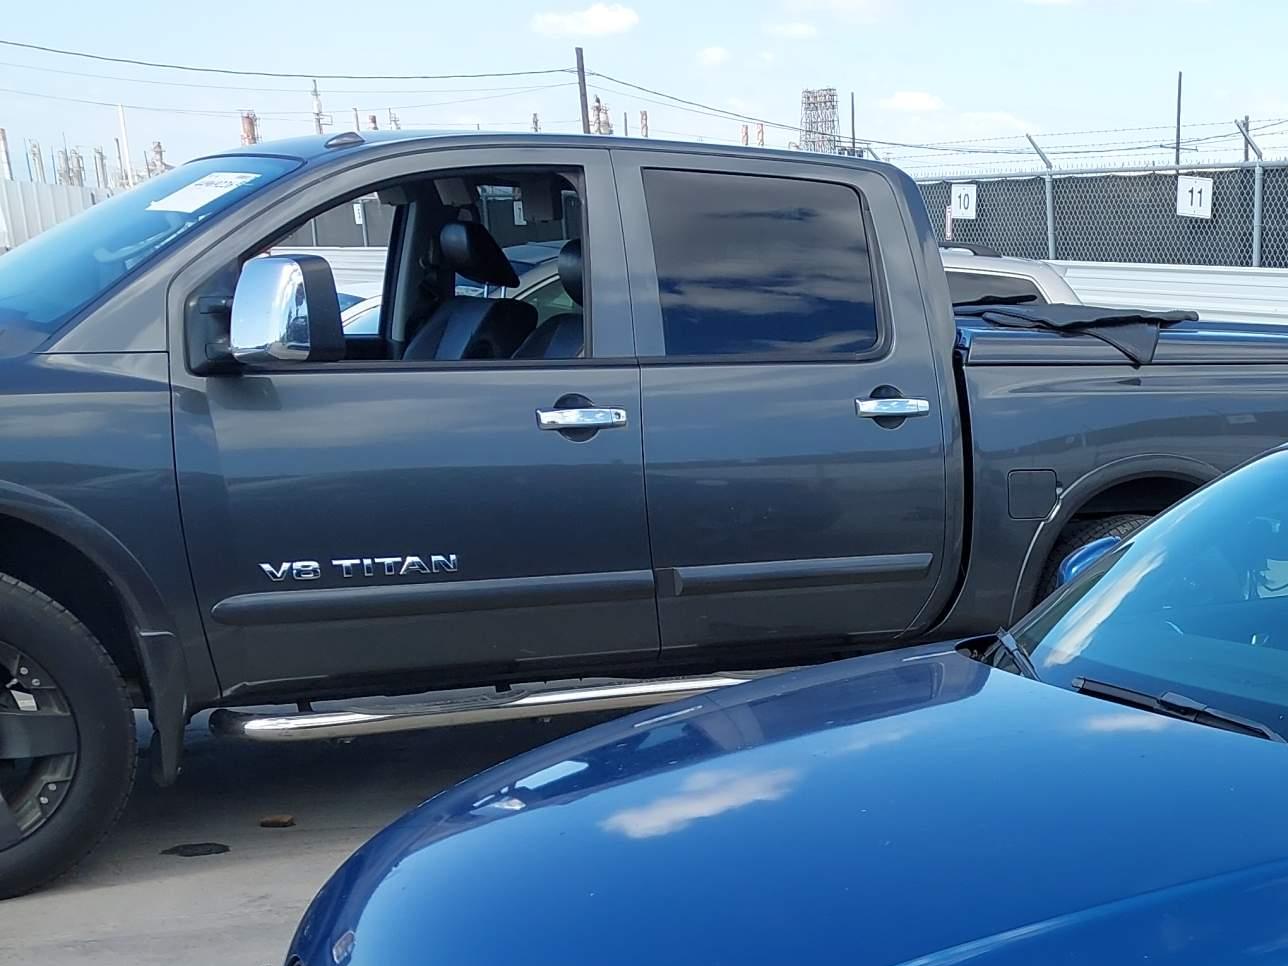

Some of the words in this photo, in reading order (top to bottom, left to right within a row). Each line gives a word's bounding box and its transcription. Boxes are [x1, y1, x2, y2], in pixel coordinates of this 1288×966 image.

[958, 193, 970, 210] 10
[1188, 186, 1203, 207] 11
[259, 561, 321, 582] V8
[332, 553, 458, 578] TITAN
